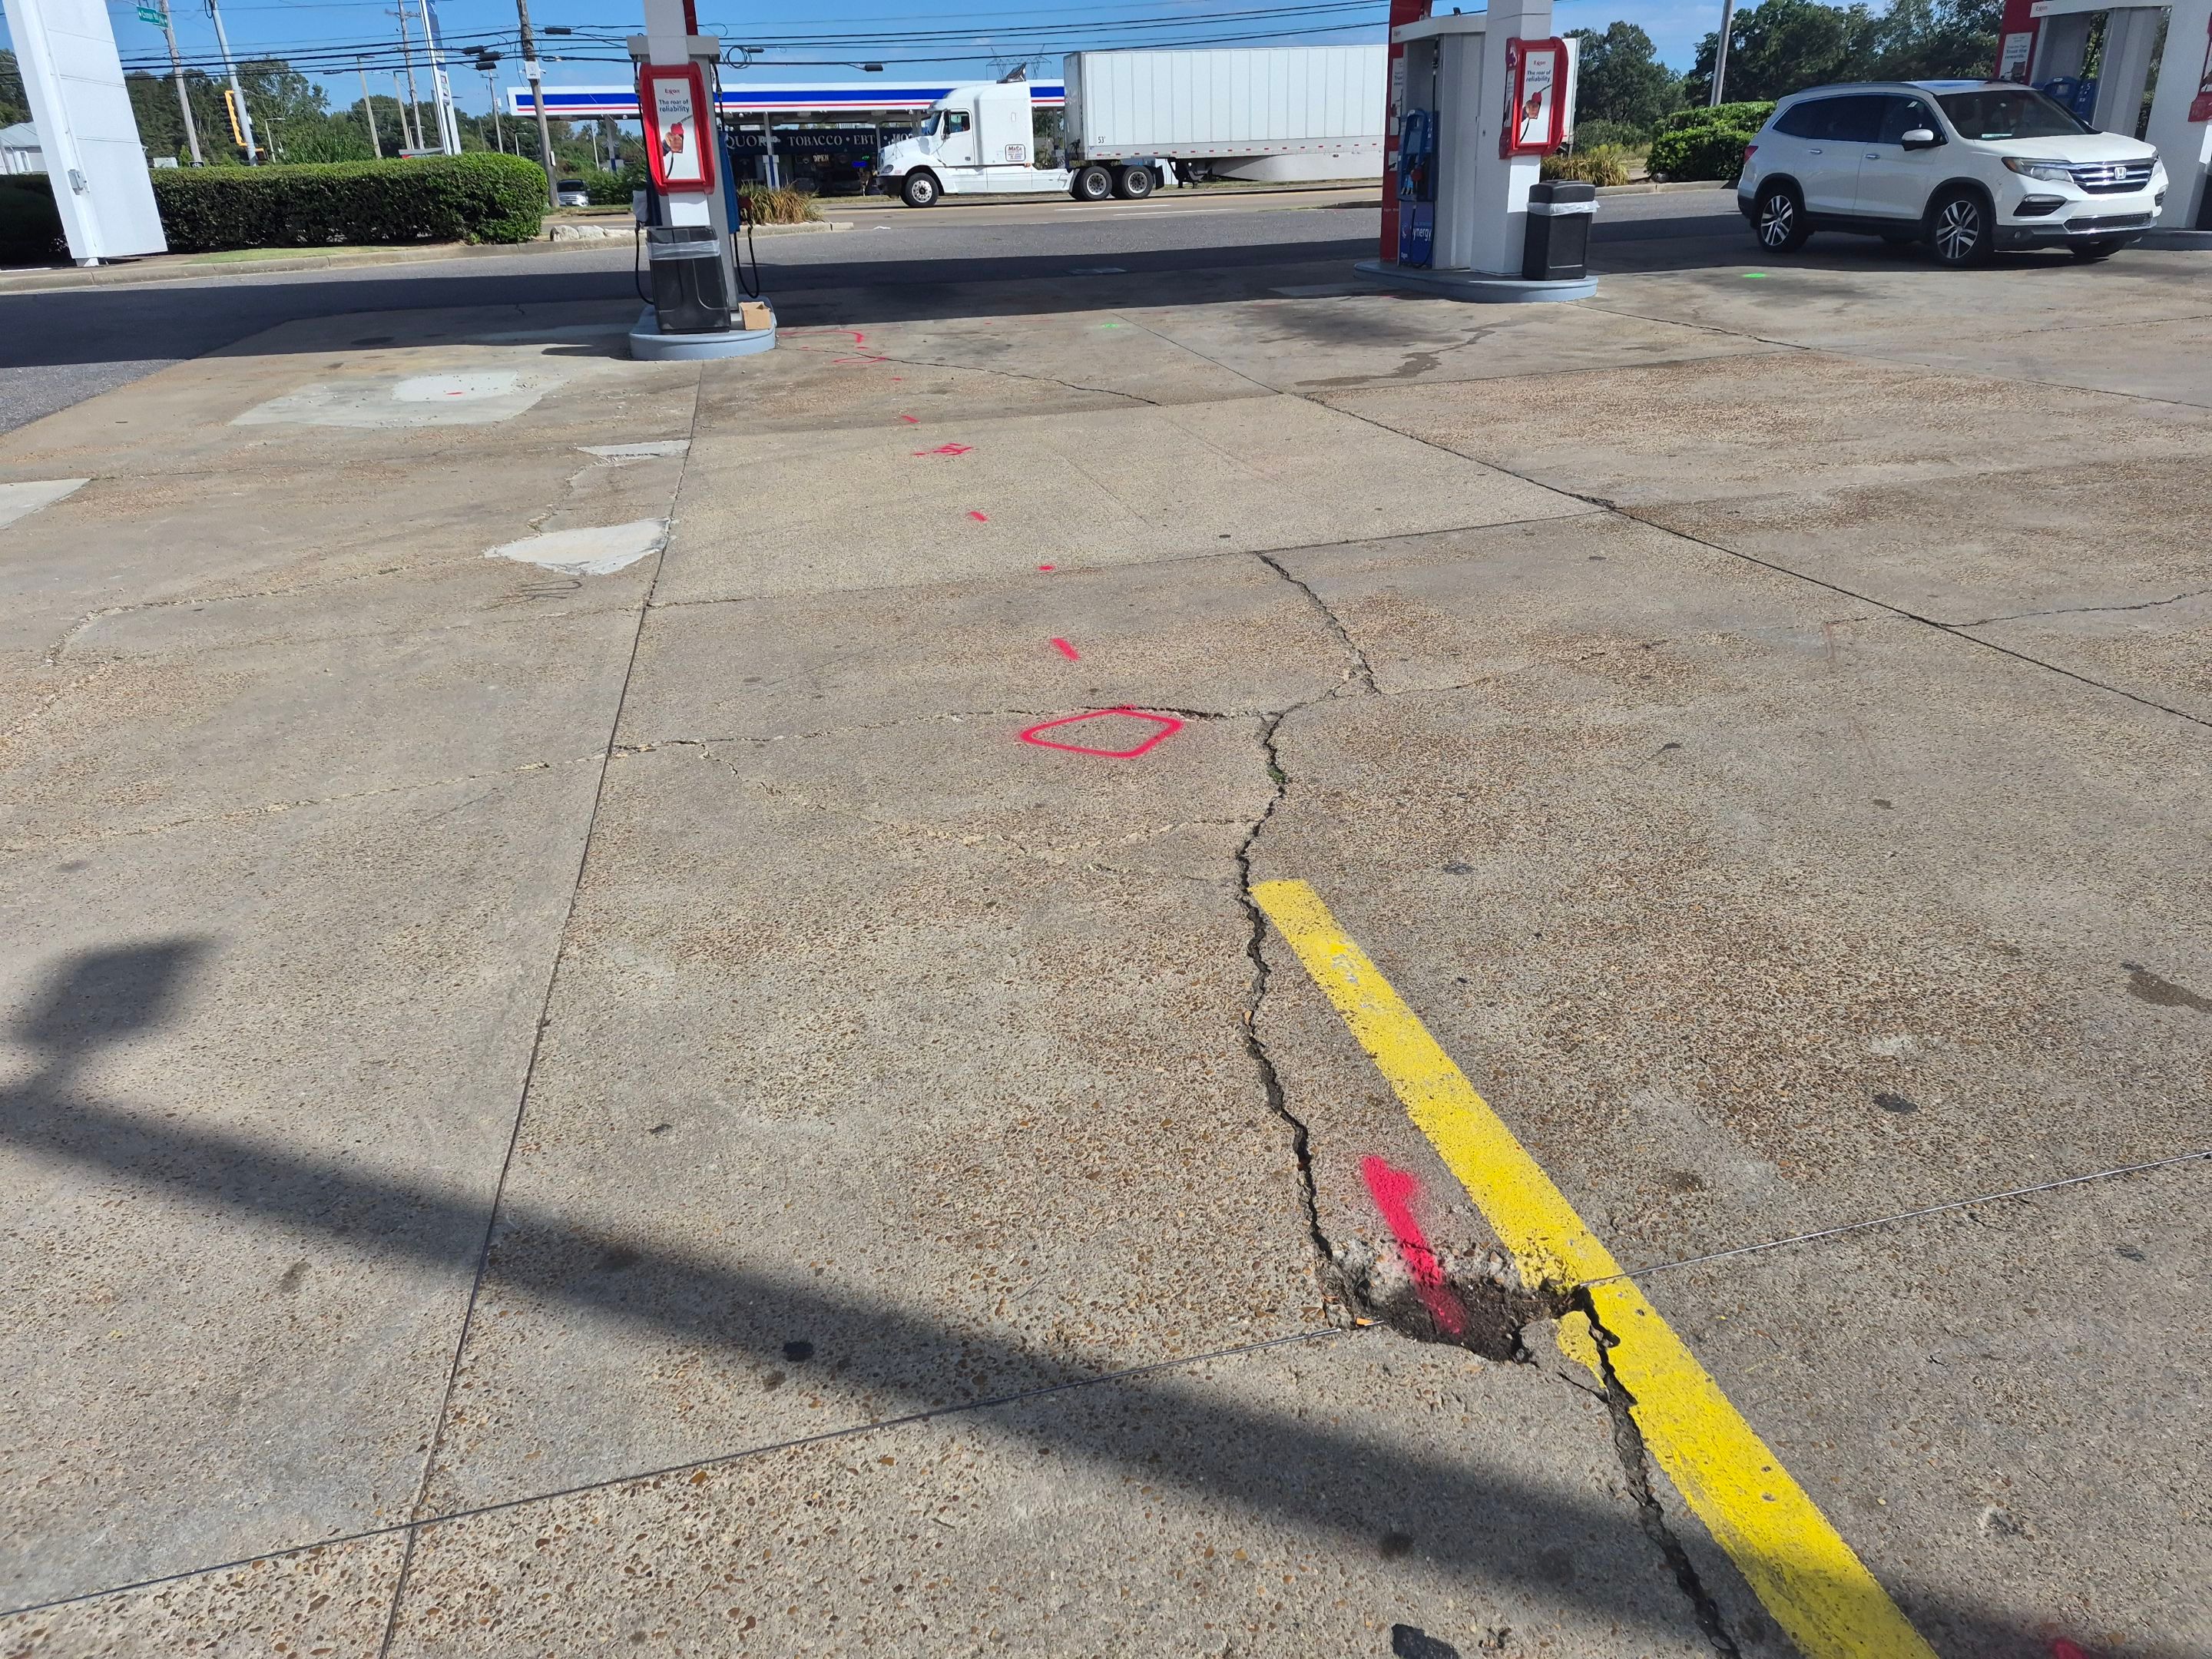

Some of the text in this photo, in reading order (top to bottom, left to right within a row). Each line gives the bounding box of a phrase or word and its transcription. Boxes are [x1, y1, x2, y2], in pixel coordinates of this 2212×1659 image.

[726, 135, 768, 149] QUOR
[788, 135, 843, 147] TOBACCO
[853, 134, 875, 145] EBT
[1411, 227, 1432, 241] ynergy
